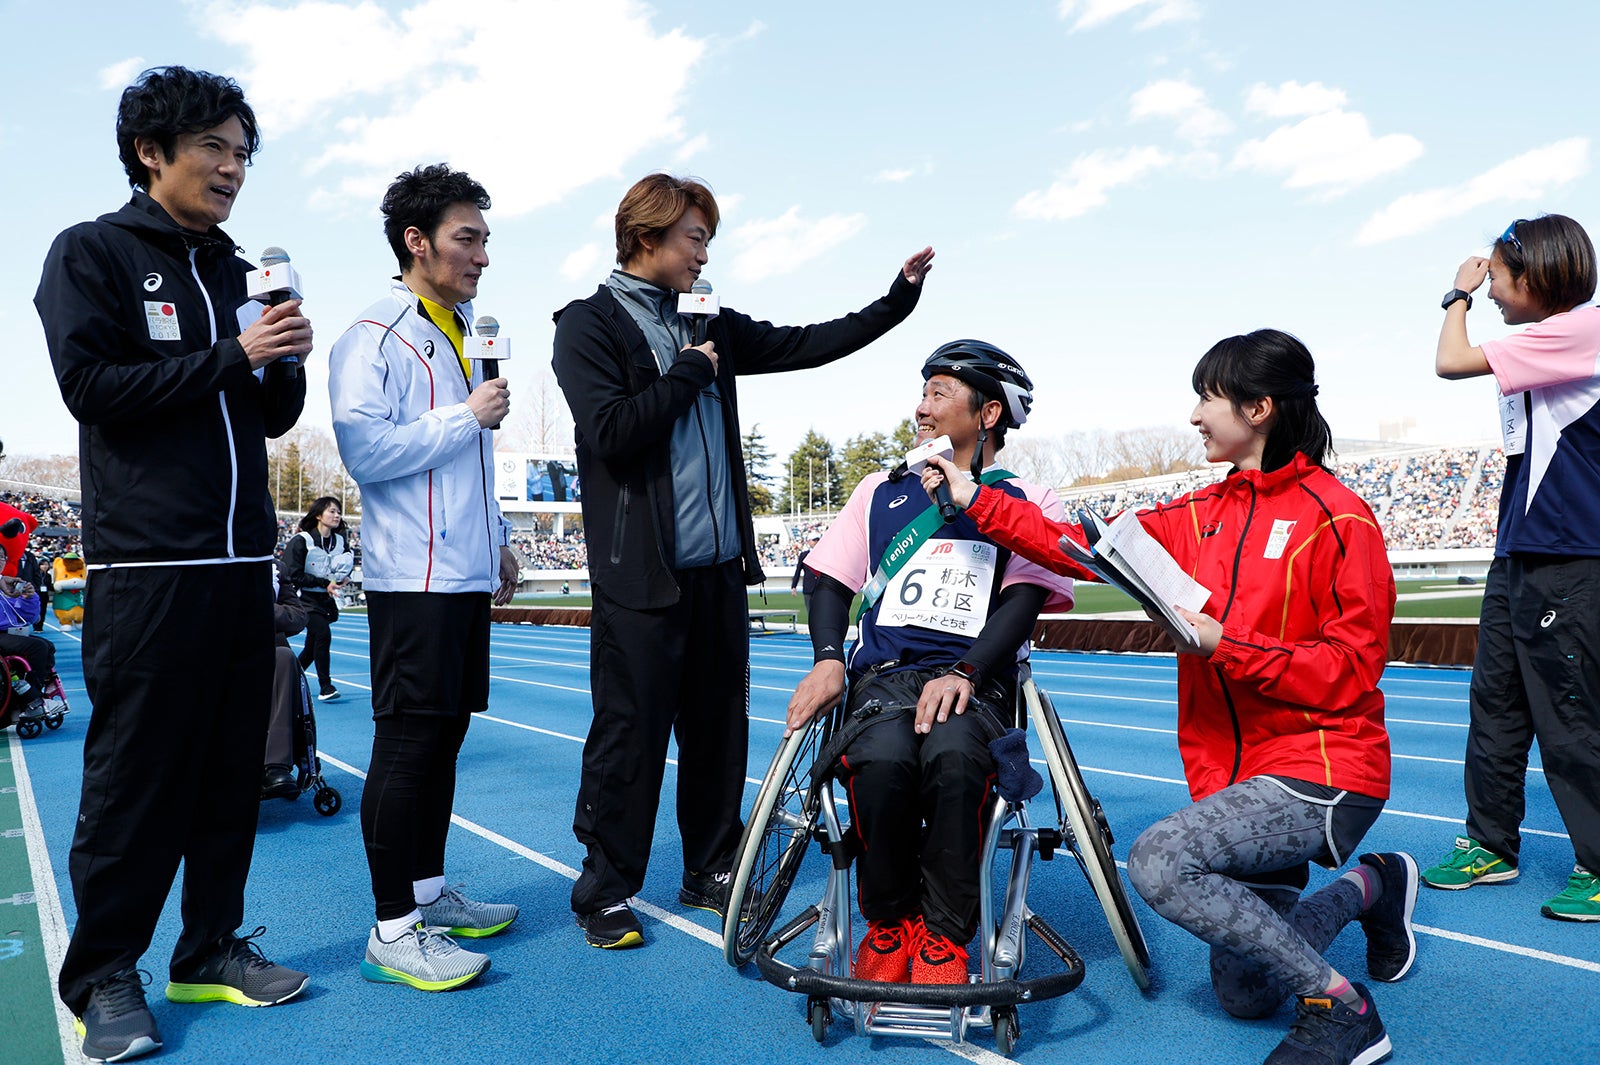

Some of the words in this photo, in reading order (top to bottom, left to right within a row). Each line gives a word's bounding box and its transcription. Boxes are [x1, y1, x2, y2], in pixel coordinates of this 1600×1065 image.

[890, 533, 914, 562] enjoy
[931, 542, 954, 555] JTB
[899, 568, 926, 606] 6
[940, 567, 978, 588] 栃木
[932, 587, 974, 612] 8区
